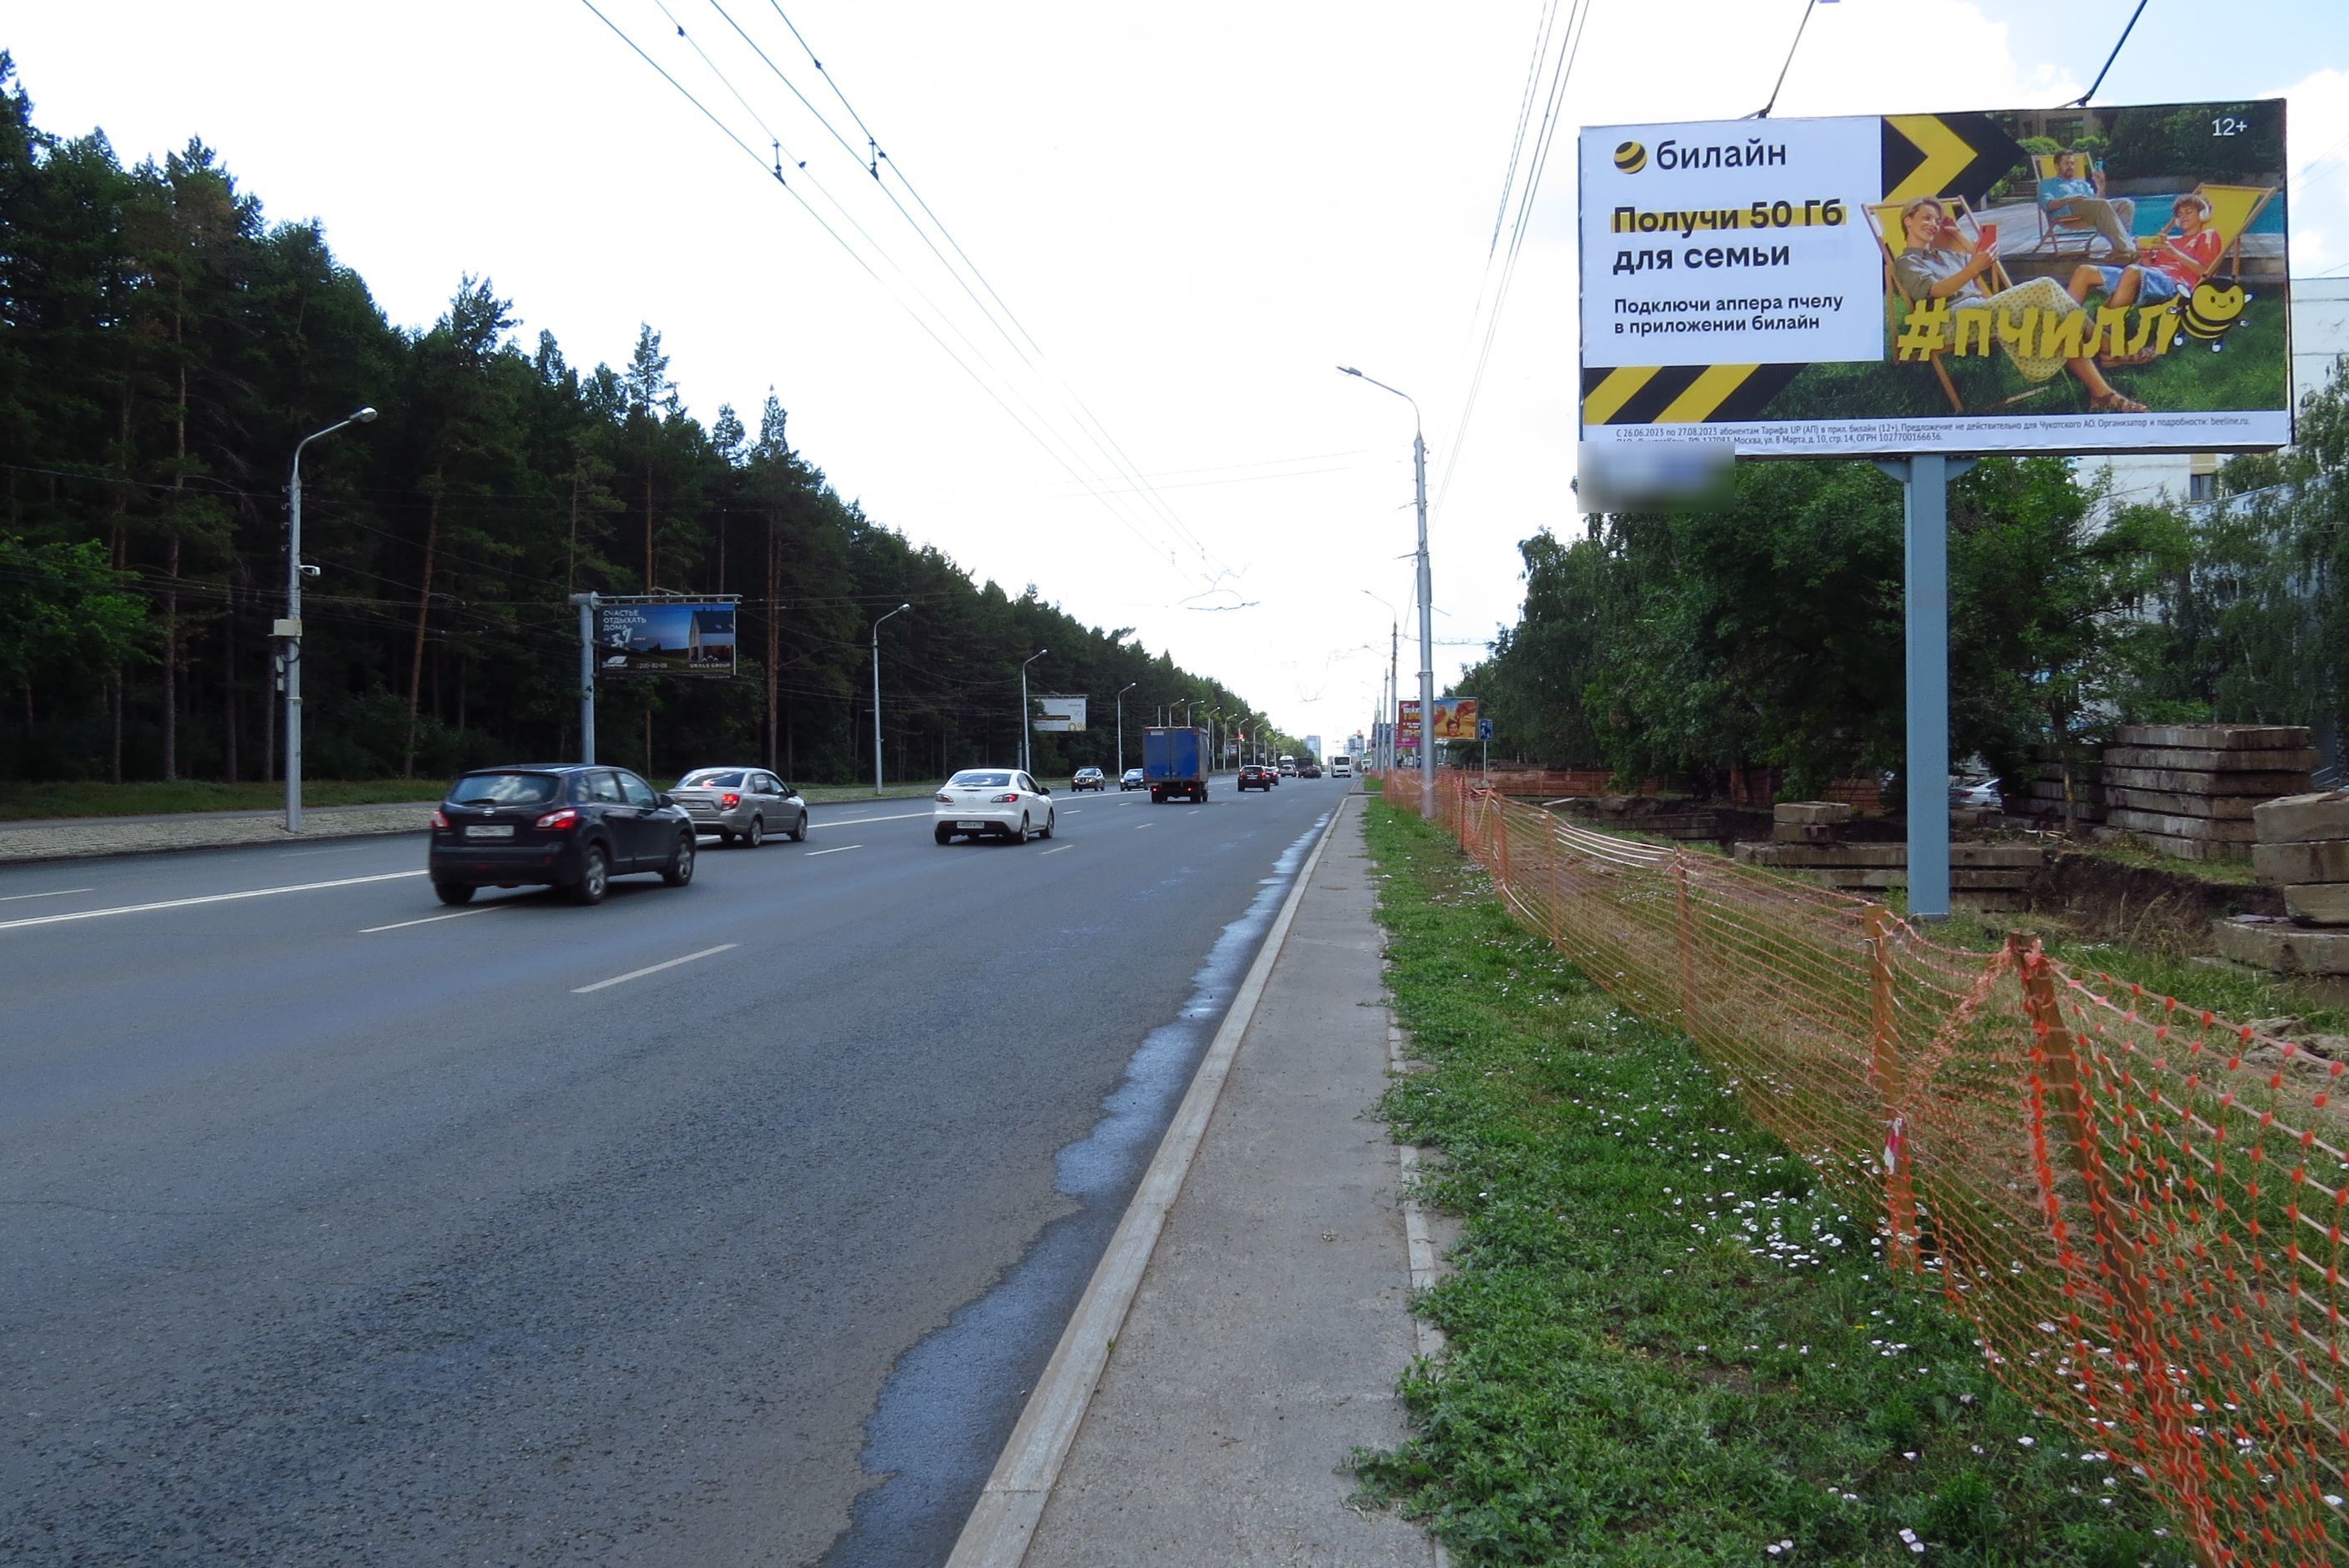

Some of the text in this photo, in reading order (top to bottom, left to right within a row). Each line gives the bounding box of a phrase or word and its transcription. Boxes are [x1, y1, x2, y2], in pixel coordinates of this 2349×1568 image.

[2211, 118, 2248, 136] 12+
[1657, 138, 1786, 170] билайн
[1614, 199, 1843, 239] Получи 50 Гб
[1612, 245, 1790, 275] для семьи
[1614, 295, 1843, 316] Подключи аппера пчелу
[1614, 314, 1820, 337] в приложении билайн
[1616, 429, 1622, 437] С
[1624, 428, 1664, 437] 26.06.2023
[1666, 429, 1676, 437] по
[1678, 427, 1718, 436] 27.08.2023
[1719, 426, 1759, 435] абонентам
[1761, 426, 1788, 436] Тарифа
[1790, 425, 1801, 435] UP
[1849, 424, 1877, 434] билайн
[1901, 423, 1953, 432] Предложение
[1966, 421, 2021, 431] действительно
[2023, 422, 2037, 430] для
[2039, 420, 2082, 430] Чукотского
[2098, 419, 2148, 429] Организатор
[1776, 435, 1781, 444] 8
[1782, 435, 1808, 445] Марта,
[1856, 433, 1877, 442] ОГРН
